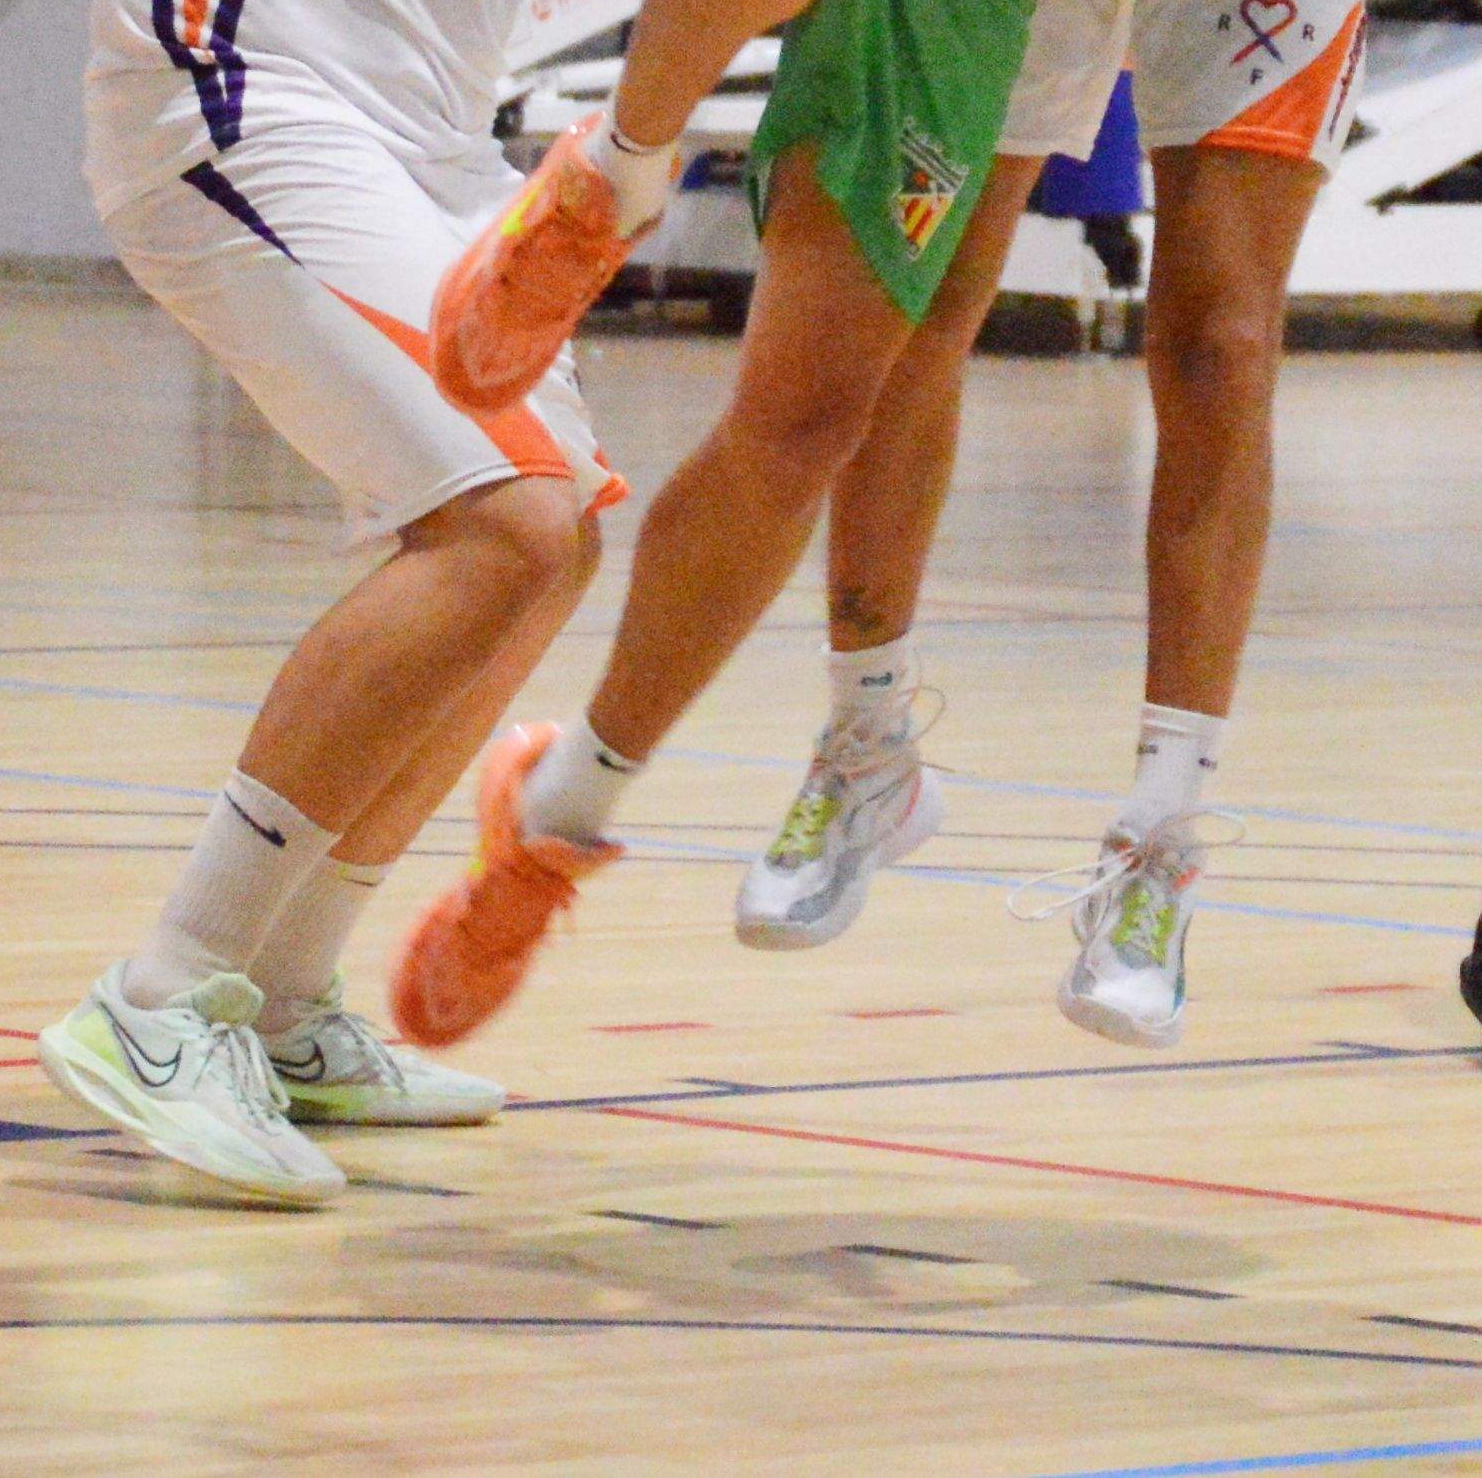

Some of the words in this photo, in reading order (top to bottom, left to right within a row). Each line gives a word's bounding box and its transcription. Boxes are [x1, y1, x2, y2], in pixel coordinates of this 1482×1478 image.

[1218, 12, 1232, 31] R
[1302, 23, 1315, 41] R
[1249, 67, 1264, 85] F
